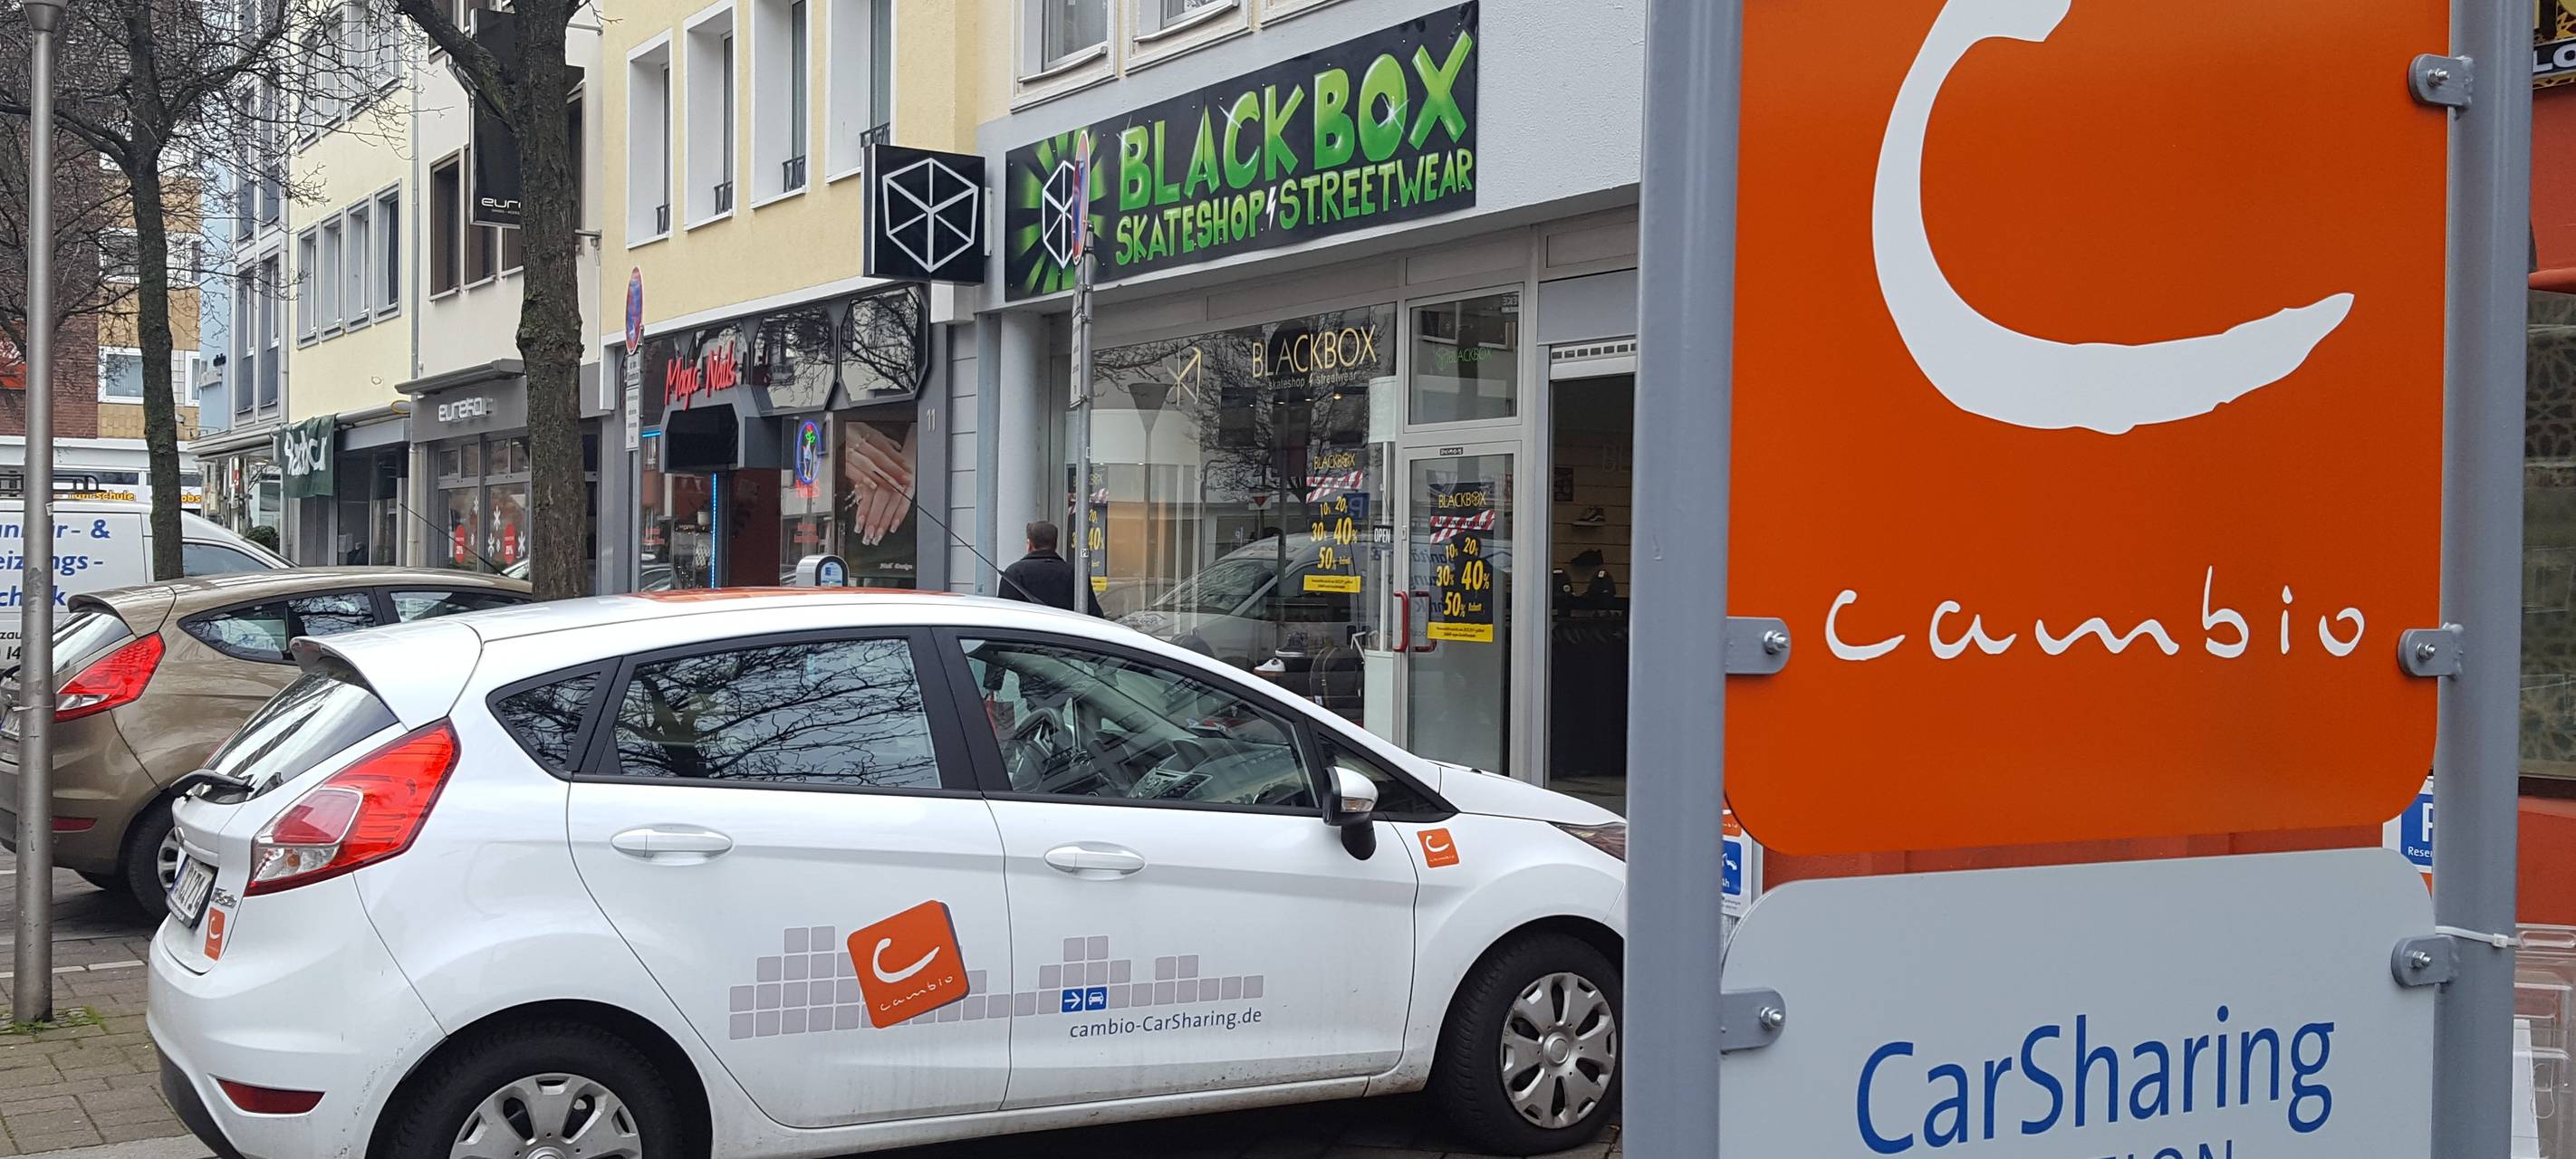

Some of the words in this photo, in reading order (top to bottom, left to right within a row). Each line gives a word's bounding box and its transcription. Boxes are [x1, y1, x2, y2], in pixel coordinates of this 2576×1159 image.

[1118, 83, 1304, 211] BLACK
[1313, 31, 1473, 171] BOX
[481, 197, 521, 208] eur
[1116, 190, 1266, 265] SKATESHOP
[1277, 148, 1473, 230] STREETWEAR
[1252, 324, 1377, 378] BLACKBOX
[1447, 348, 1493, 363] BLACKBOX
[665, 356, 700, 412] Magic
[706, 340, 738, 398] Nails
[1269, 376, 1305, 390] skateshop
[1316, 370, 1357, 386] streetwear
[927, 408, 936, 432] 11
[1314, 453, 1355, 469] BLACKBOX
[181, 493, 201, 503] obs
[1438, 492, 1485, 508] BLACKBOX
[91, 519, 111, 539] &
[1374, 528, 1391, 543] OPEN
[1461, 560, 1490, 589] 40%
[0, 585, 66, 607] chk
[1825, 566, 2365, 661] cambio
[879, 975, 954, 1011] cambio
[1070, 1007, 1263, 1039] cambio-CarSharing.de
[1856, 1005, 2334, 1154] CarSharing
